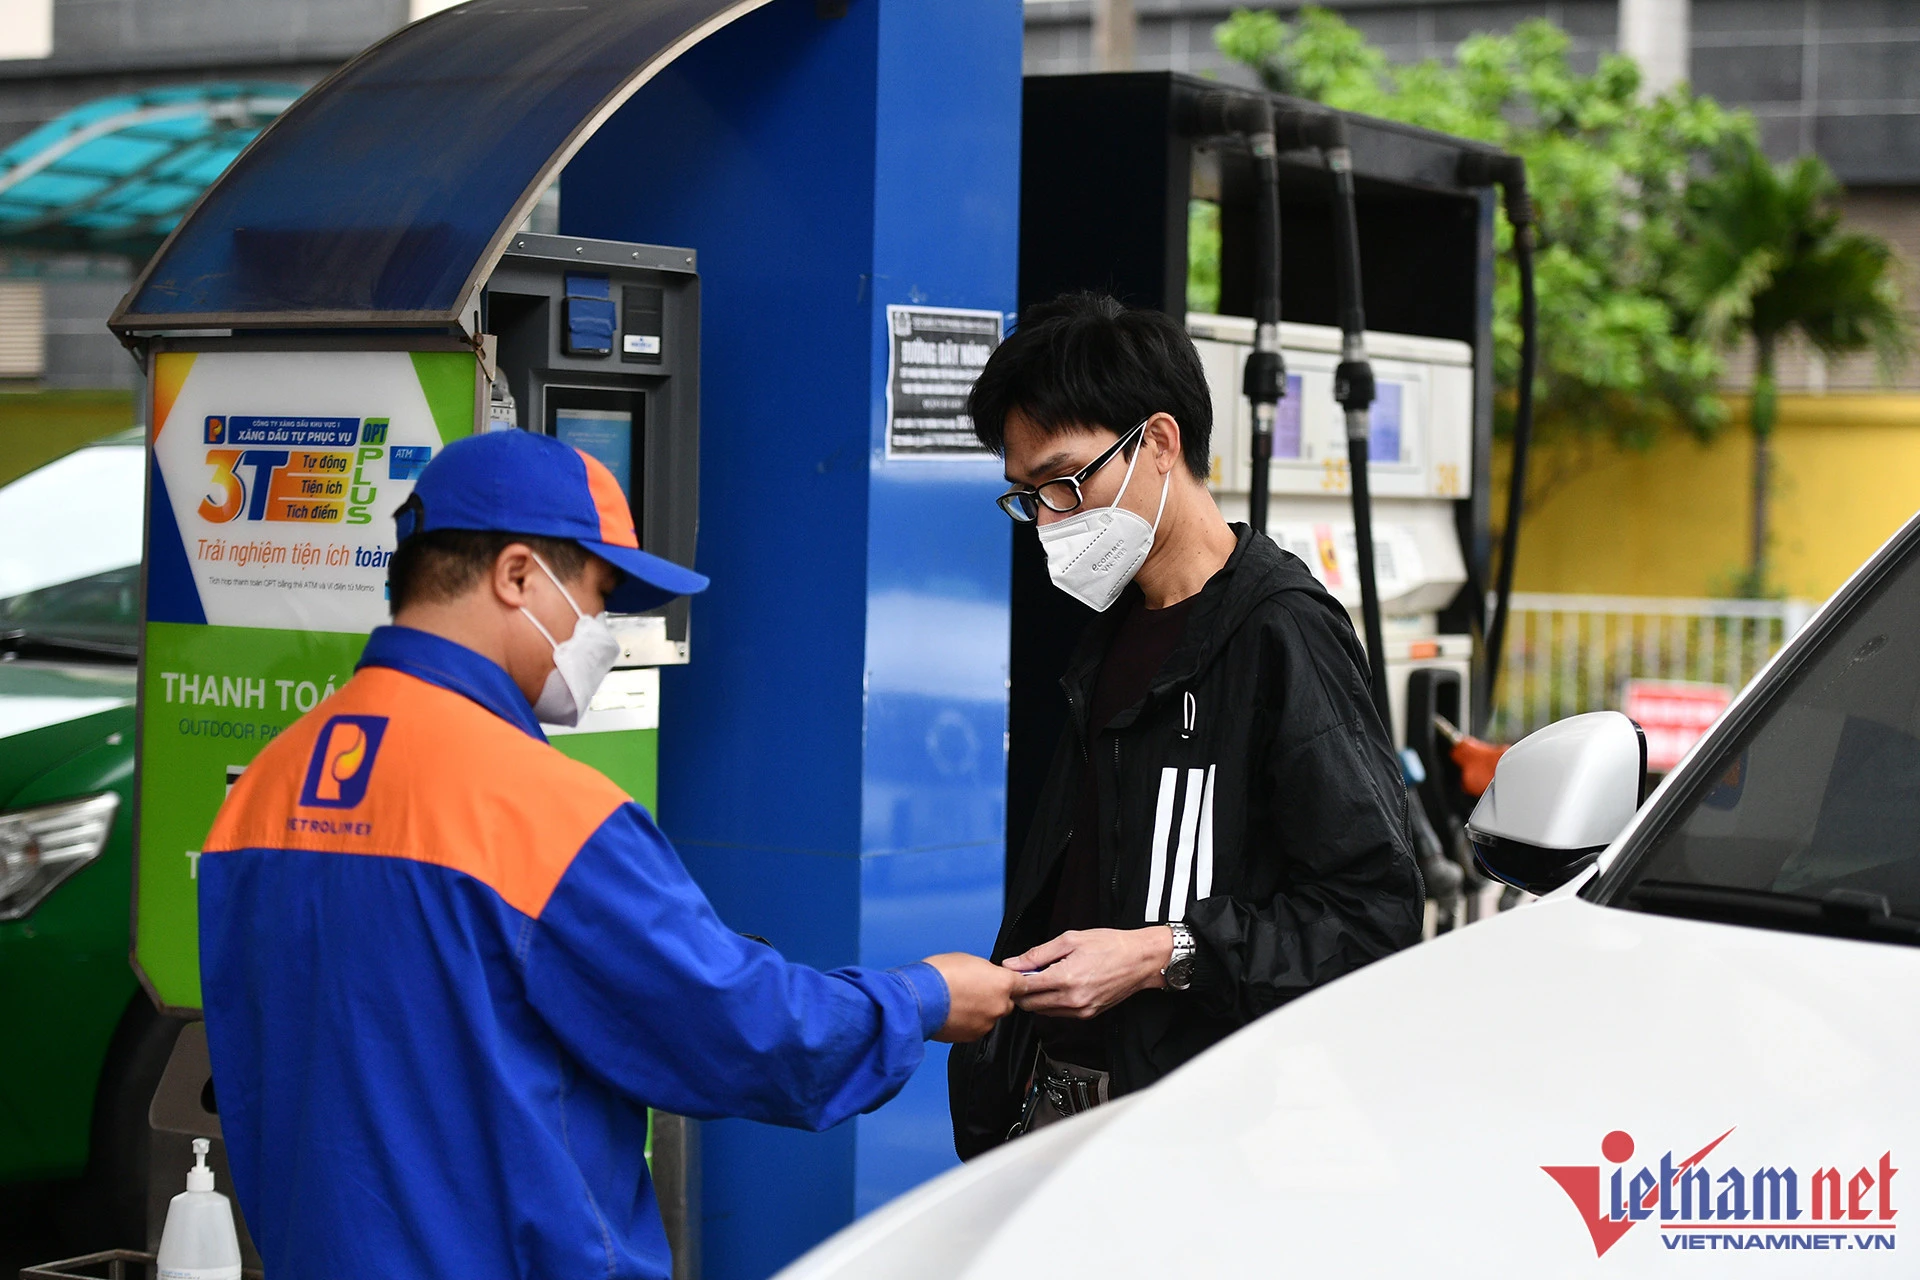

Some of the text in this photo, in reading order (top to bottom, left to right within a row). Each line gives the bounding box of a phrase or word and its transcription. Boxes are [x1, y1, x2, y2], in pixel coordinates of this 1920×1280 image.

[238, 428, 352, 445] XĂNG DẦU TỰ PHỤC VỤ
[362, 423, 388, 442] OPT
[395, 448, 413, 459] ATM
[303, 455, 347, 472] Tự động
[197, 449, 290, 524] 3T
[301, 480, 342, 497] Tiện ích
[346, 448, 384, 524] PLUS
[311, 503, 338, 520] điểm
[198, 539, 394, 571] Trải nghiệm tiện ích toàn
[303, 581, 318, 589] ATM
[160, 672, 346, 713] THANH TOÁ
[179, 718, 255, 740] OUTDOOR
